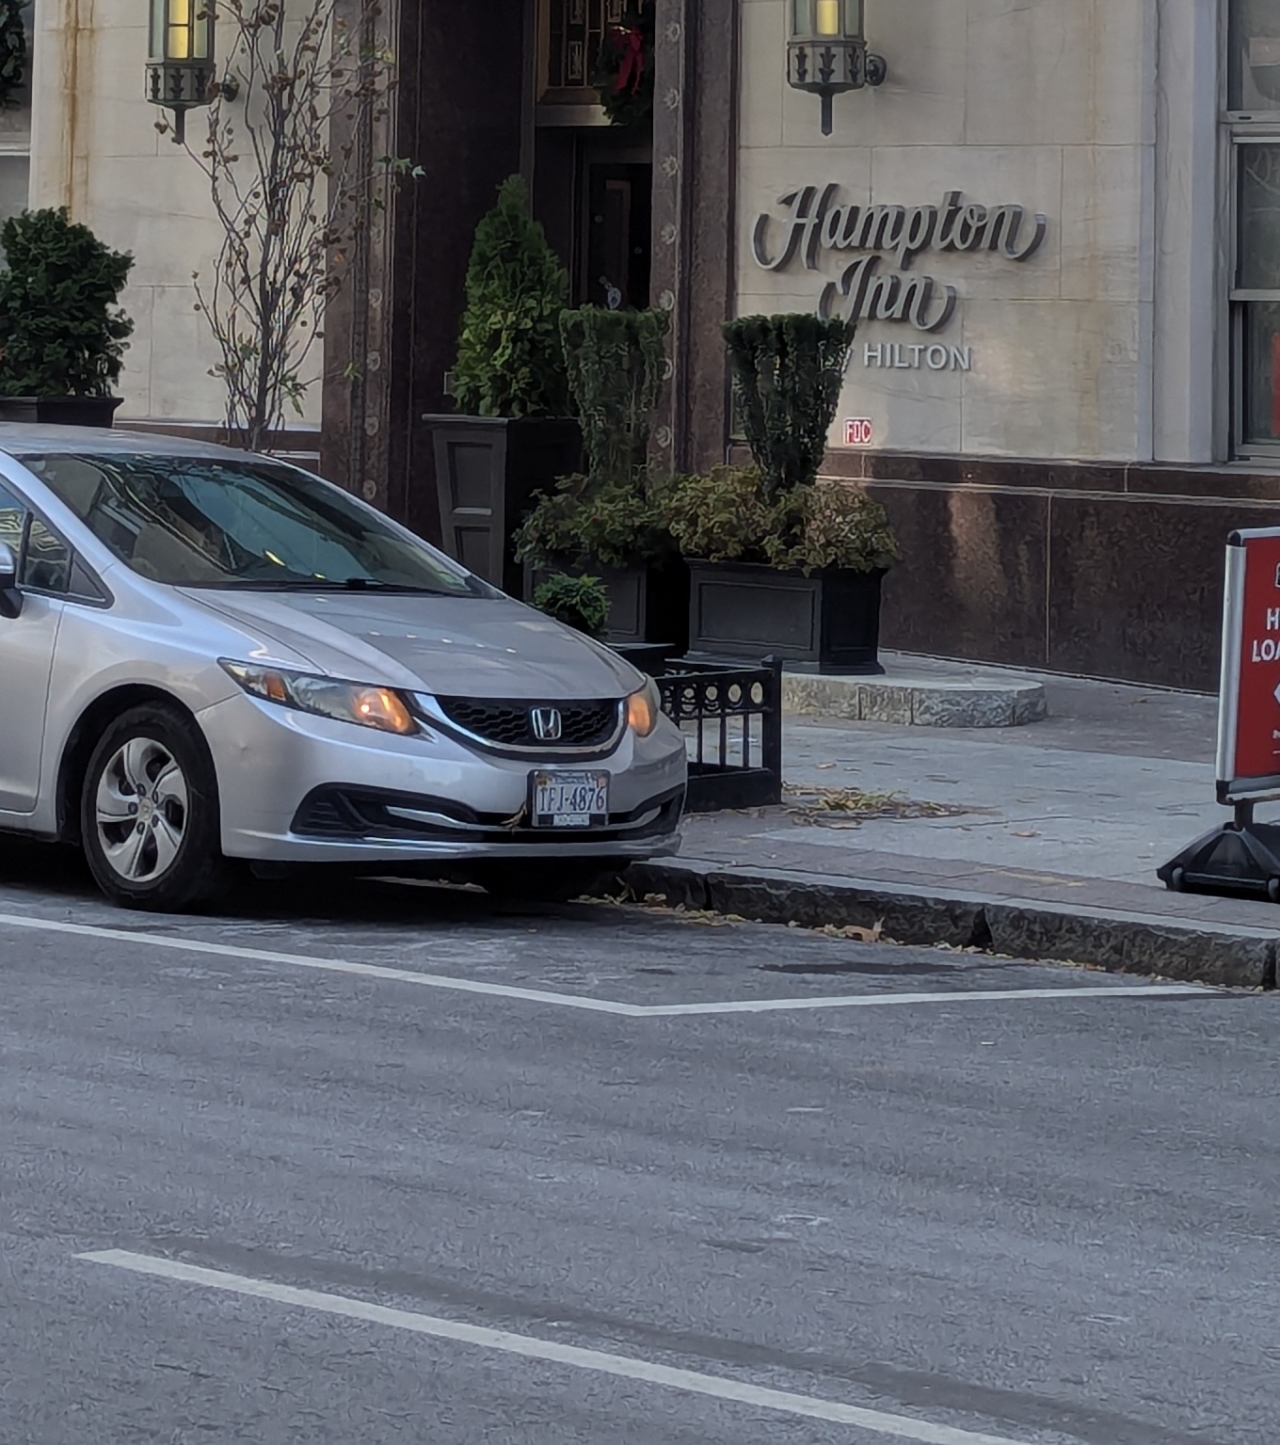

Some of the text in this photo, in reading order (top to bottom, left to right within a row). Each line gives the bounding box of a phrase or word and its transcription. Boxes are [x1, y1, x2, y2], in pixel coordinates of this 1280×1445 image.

[750, 183, 1047, 272] Hampton
[818, 255, 957, 333] Inn
[863, 342, 972, 371] HILTON
